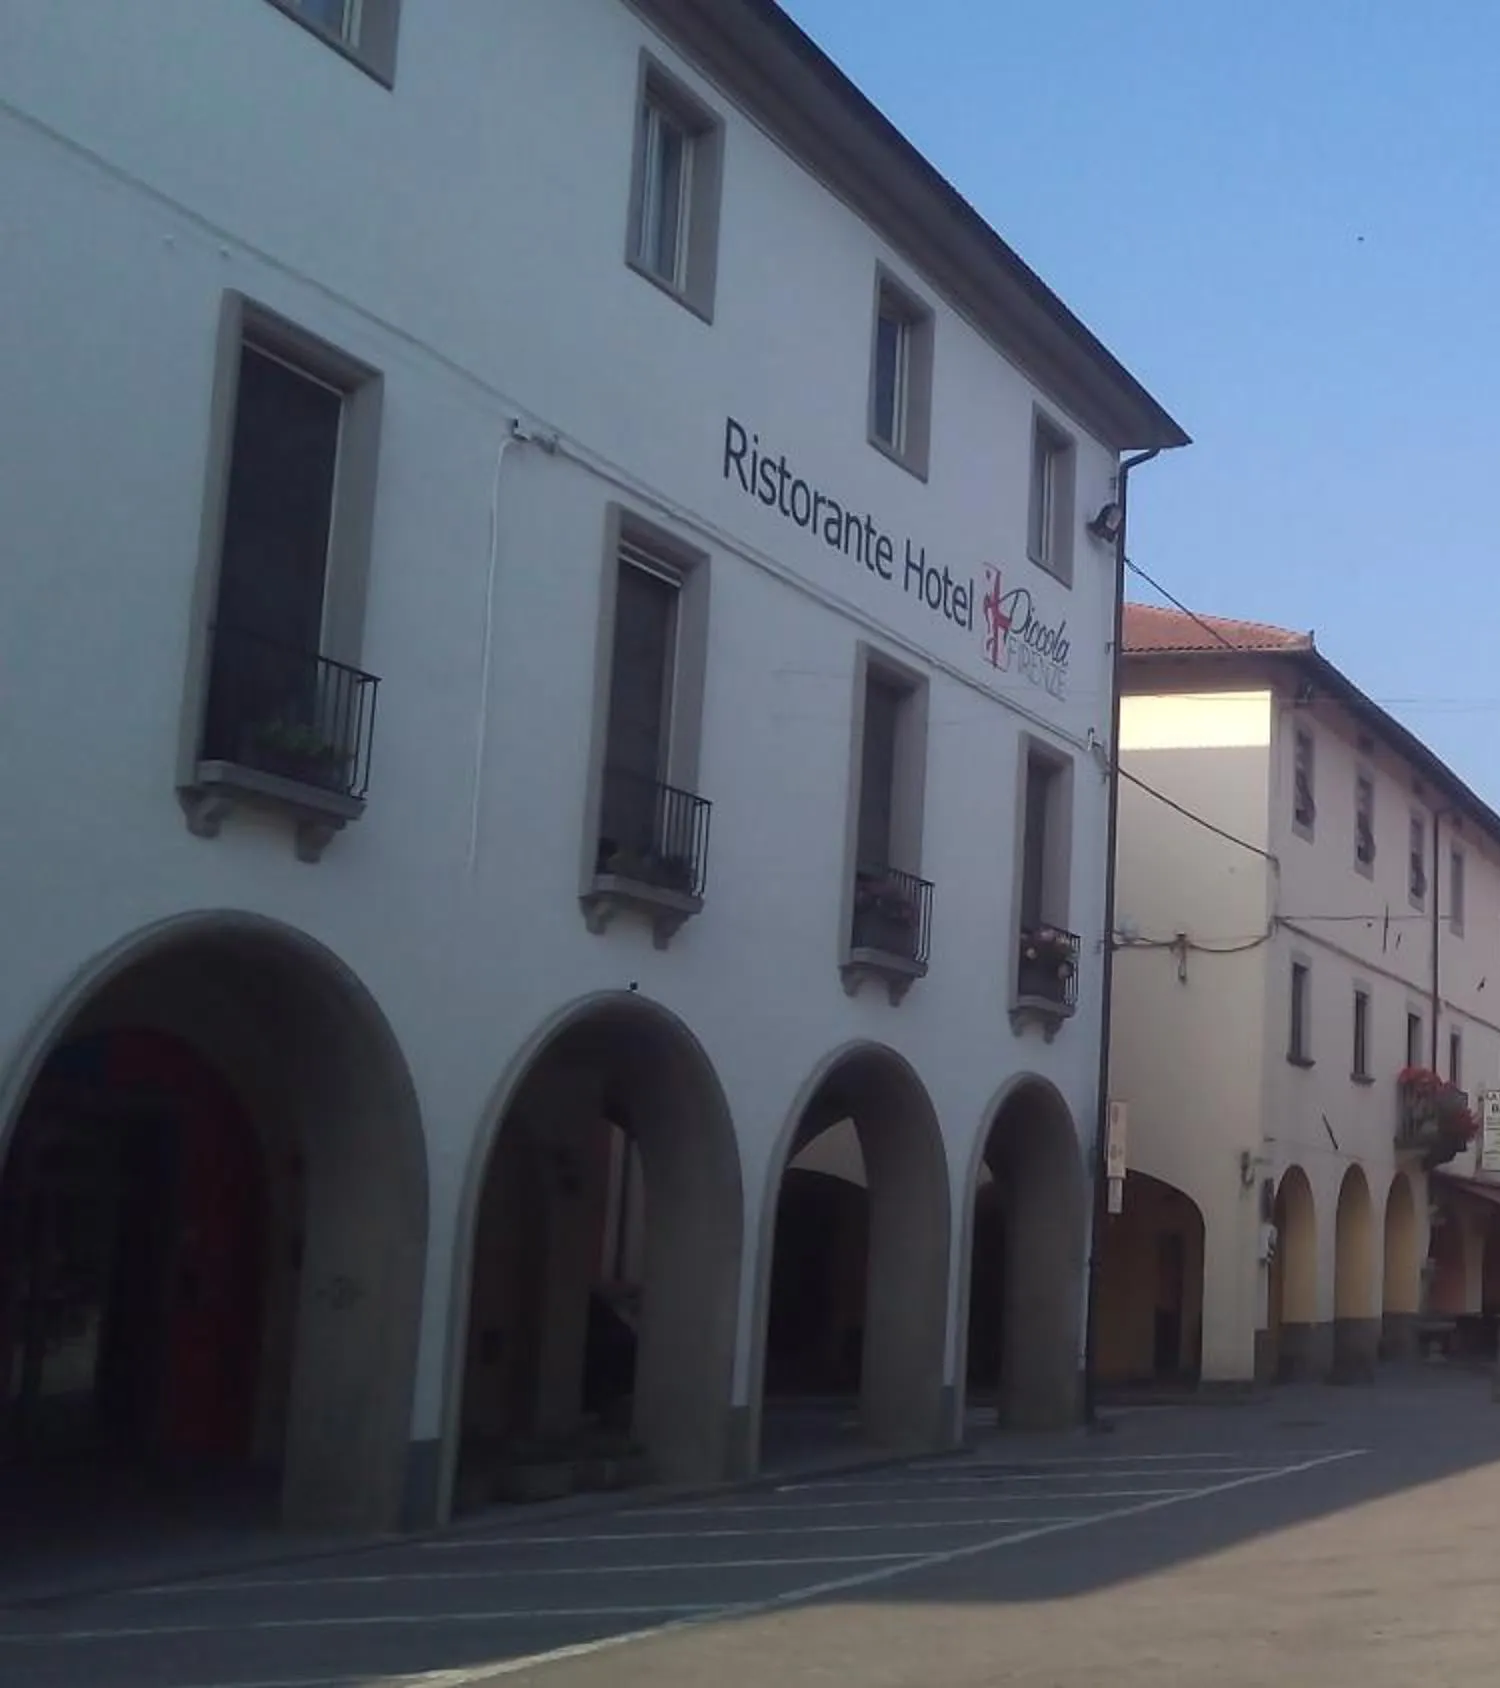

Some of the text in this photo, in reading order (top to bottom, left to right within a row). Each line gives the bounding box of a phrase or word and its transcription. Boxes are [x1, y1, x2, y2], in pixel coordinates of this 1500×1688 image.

[723, 415, 974, 631] Ristorante Hotel
[999, 587, 1070, 667] Piccola
